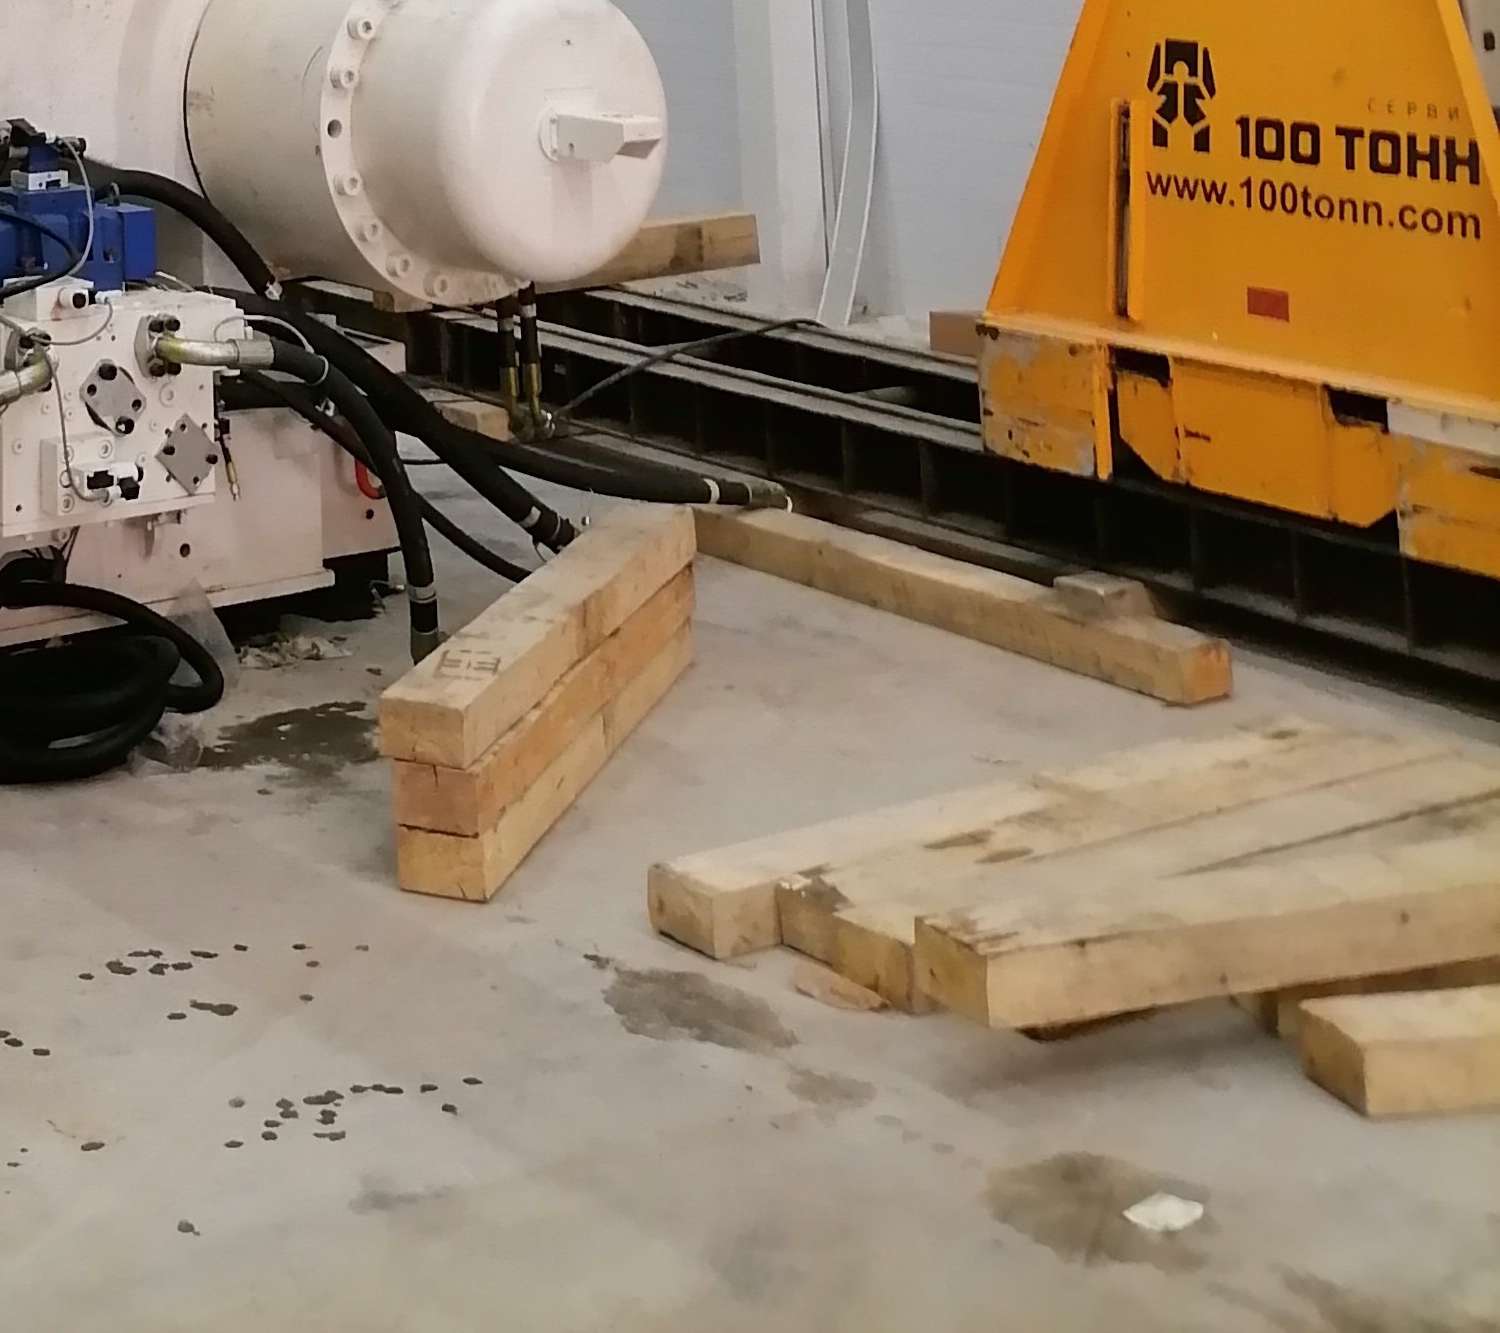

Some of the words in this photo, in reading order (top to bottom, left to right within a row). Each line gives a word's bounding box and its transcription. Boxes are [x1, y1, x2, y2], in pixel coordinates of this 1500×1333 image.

[1235, 115, 1320, 165] 100
[1335, 126, 1481, 185] ТОНН
[1147, 170, 1482, 240] www.100tonn.com
